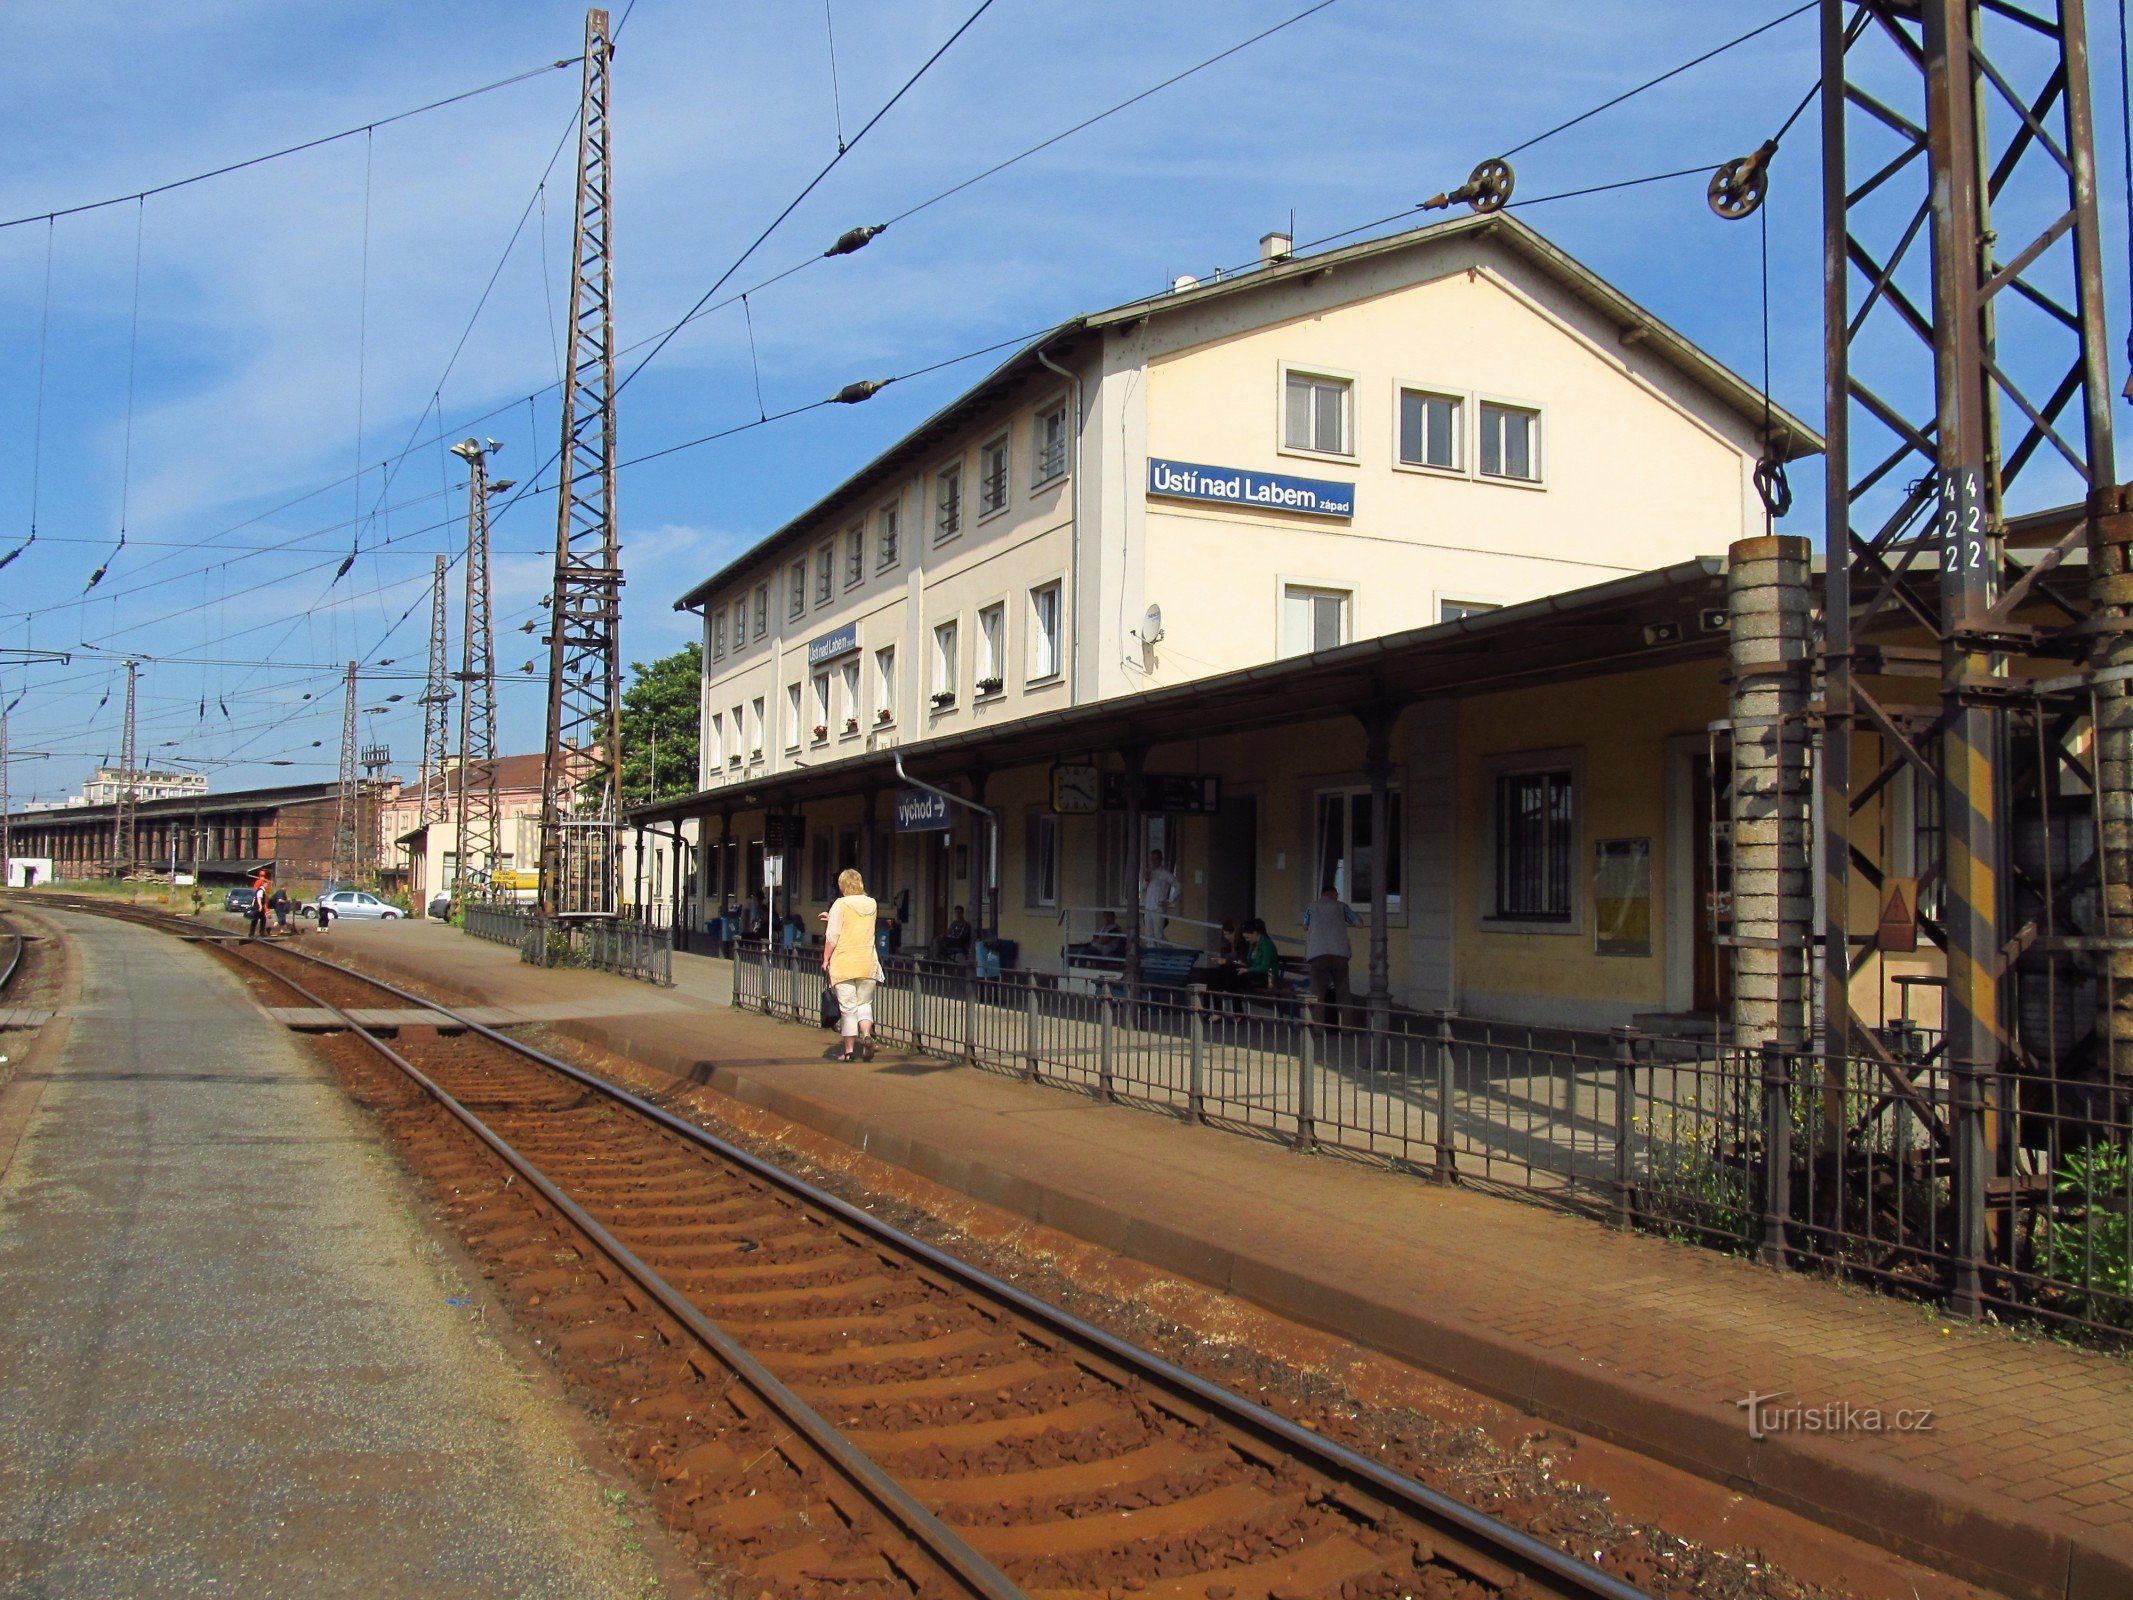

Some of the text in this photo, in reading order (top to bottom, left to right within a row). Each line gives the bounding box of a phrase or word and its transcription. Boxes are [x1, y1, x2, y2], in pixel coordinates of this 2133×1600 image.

[1154, 464, 1349, 512] Ústí nad Labem západ
[899, 796, 932, 827] východ
